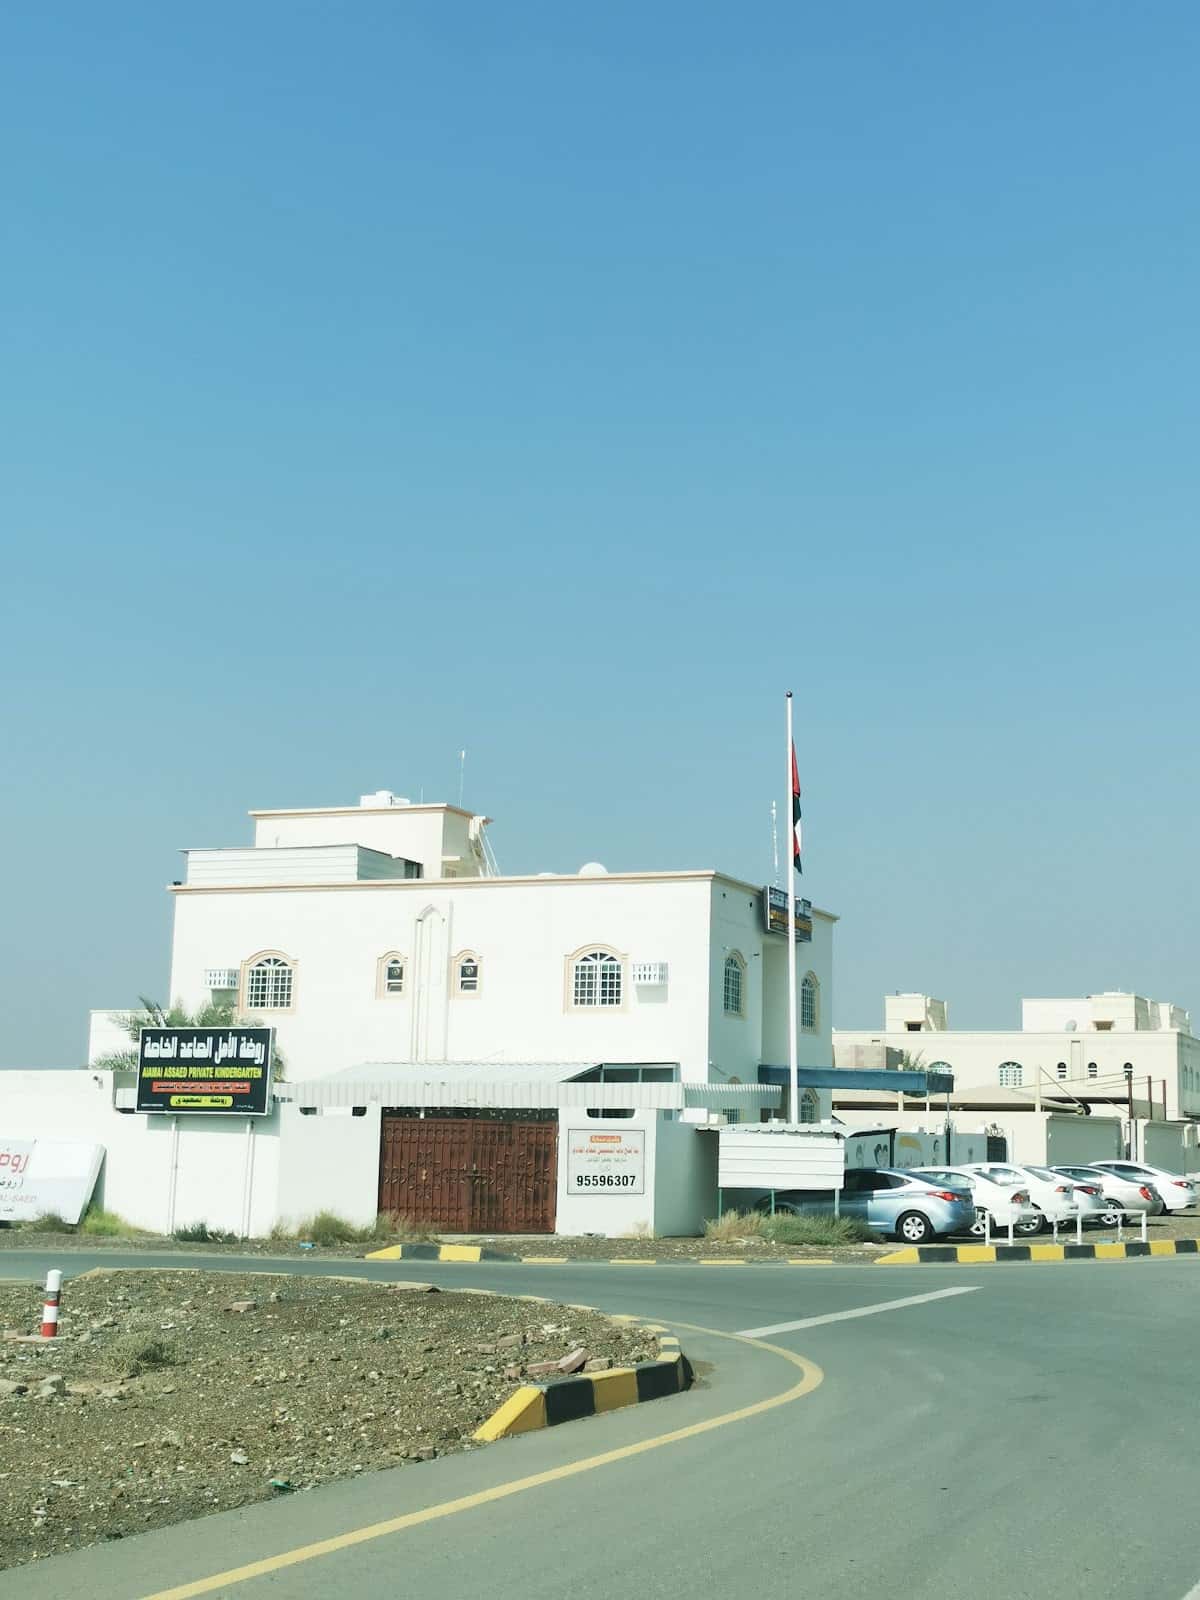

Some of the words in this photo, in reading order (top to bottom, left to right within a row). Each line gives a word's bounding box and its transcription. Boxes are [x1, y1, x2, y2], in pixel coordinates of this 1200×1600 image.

[143, 1036, 178, 1058] الخاصة
[180, 1036, 213, 1058] الصاعد
[214, 1031, 238, 1064] الأمل
[239, 1036, 265, 1064] روضة
[188, 1066, 214, 1078] PRIVATE
[576, 1175, 636, 1186] 95596307
